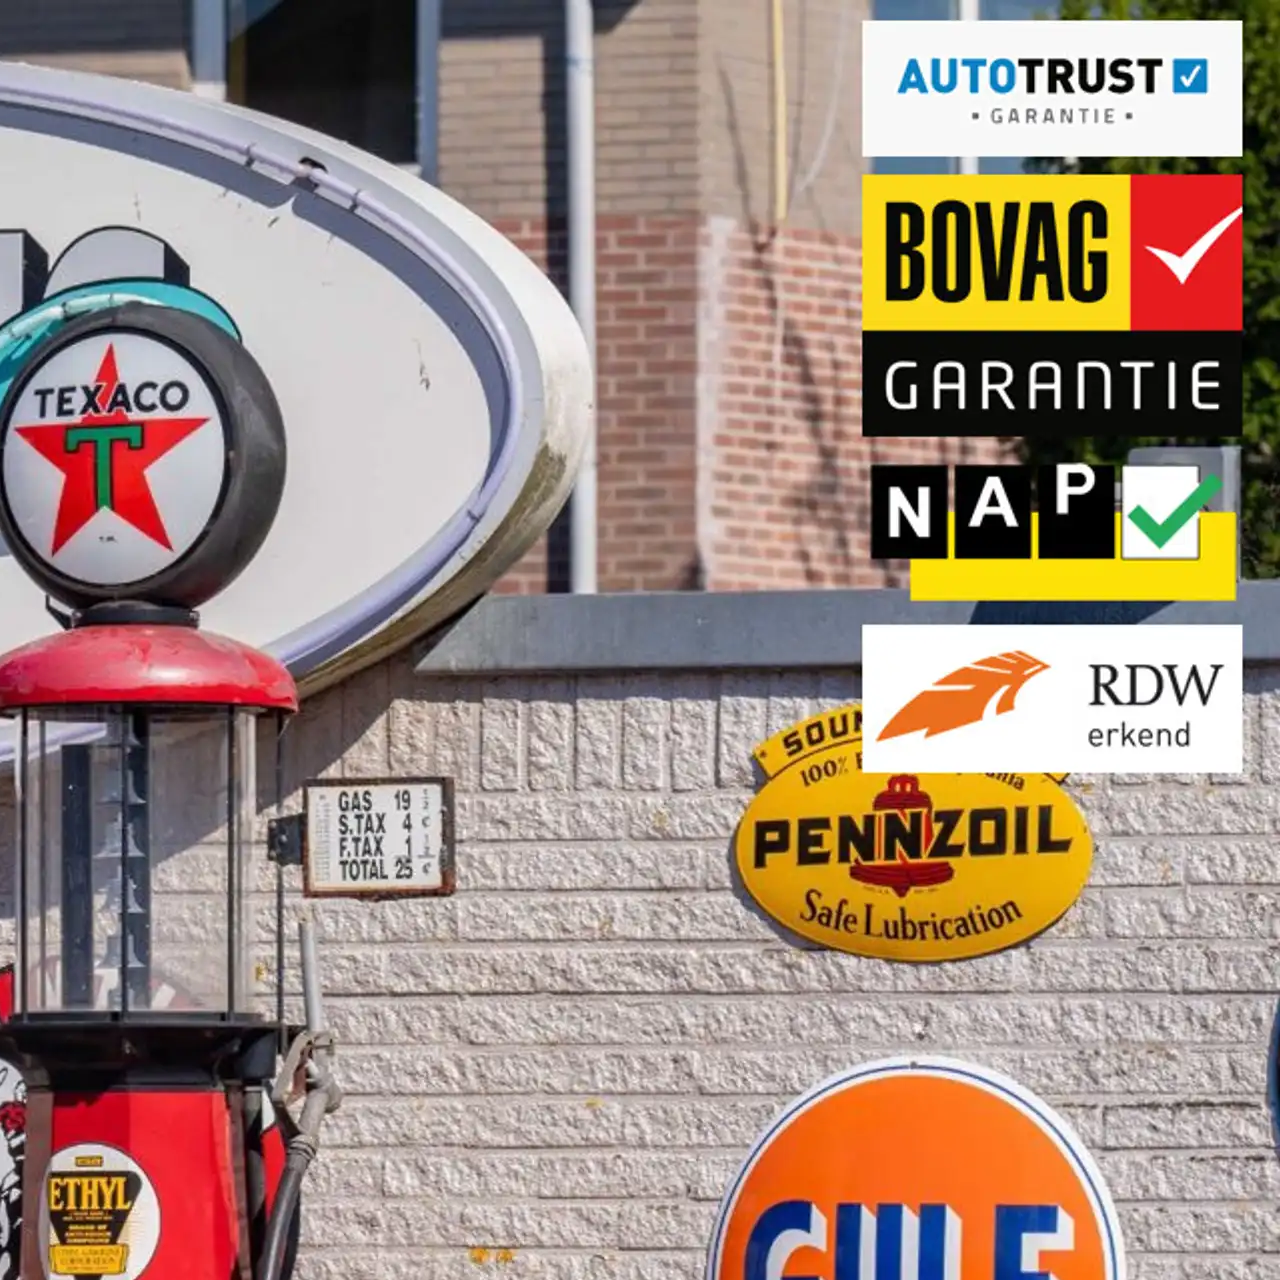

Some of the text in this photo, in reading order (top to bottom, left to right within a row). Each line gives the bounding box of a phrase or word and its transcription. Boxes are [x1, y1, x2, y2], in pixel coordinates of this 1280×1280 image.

[33, 379, 191, 419] TEXACO
[63, 422, 145, 513] T
[338, 788, 411, 812] GAS 19
[337, 812, 412, 835] S.TAX 4
[753, 804, 1074, 870] PENNZOIL
[338, 835, 385, 858] F.TAX
[338, 858, 413, 882] TOTAL 25
[799, 888, 1024, 941] Safe Lubrication
[49, 1176, 134, 1211] ETHYL
